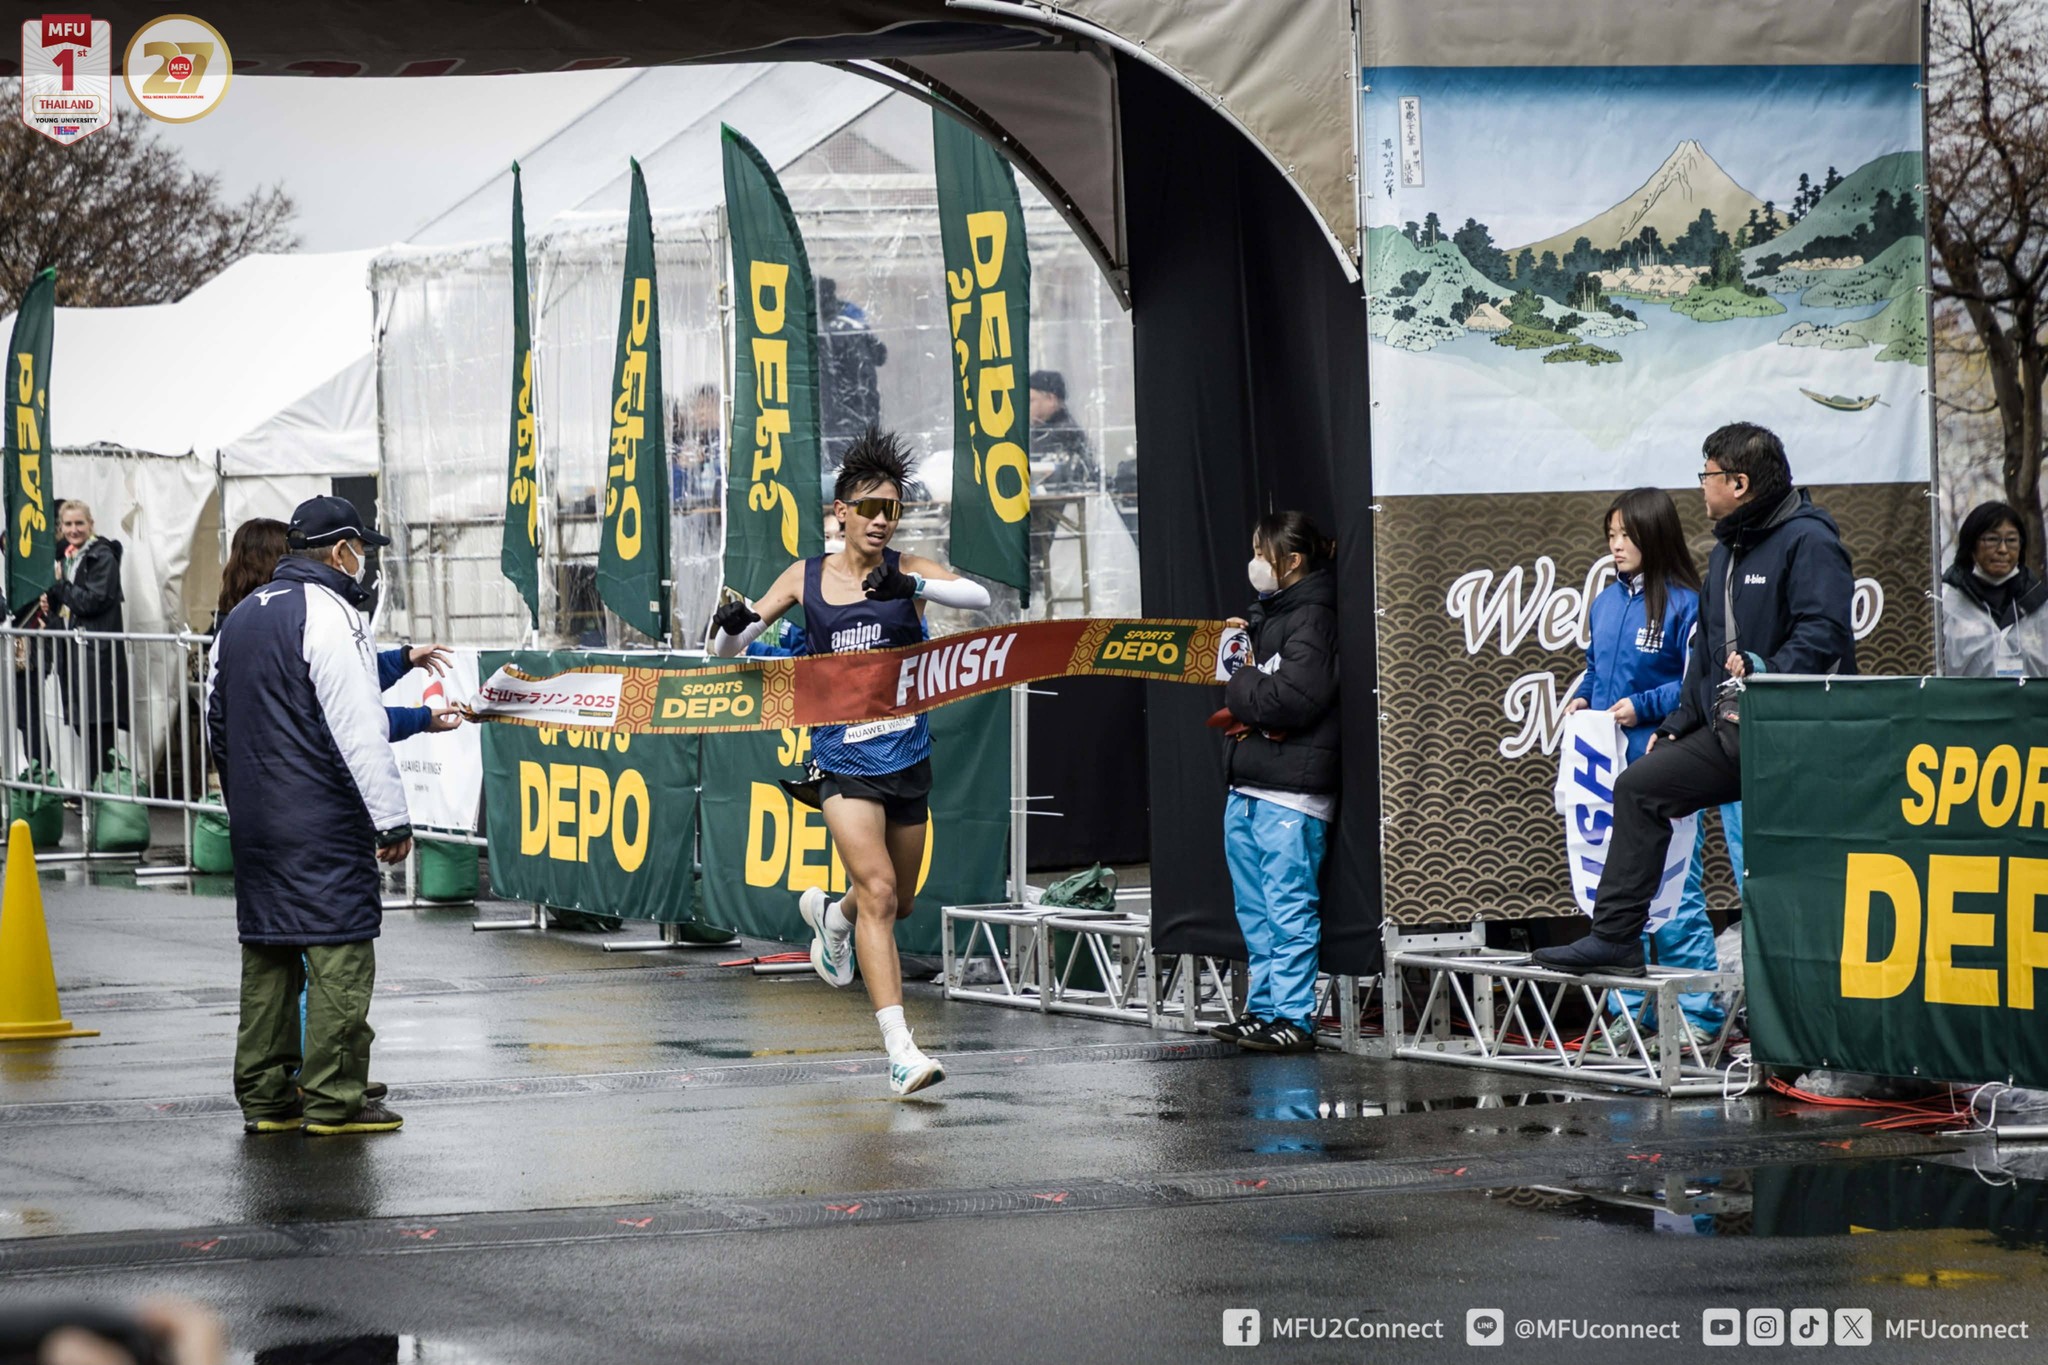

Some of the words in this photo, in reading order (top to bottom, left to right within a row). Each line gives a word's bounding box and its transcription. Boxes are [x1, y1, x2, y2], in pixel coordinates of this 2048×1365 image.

[1744, 574, 1766, 585] R-bies
[831, 621, 882, 650] amino
[1124, 630, 1175, 641] SPORTS
[1102, 641, 1179, 665] DEPO
[896, 633, 1017, 707] FINISH
[479, 682, 570, 705] 士山マラソン
[572, 693, 615, 708] 2025
[681, 680, 743, 696] SPORTS
[661, 694, 755, 719] DEPO
[847, 724, 886, 740] HUAWEI
[519, 760, 650, 873] DEPO
